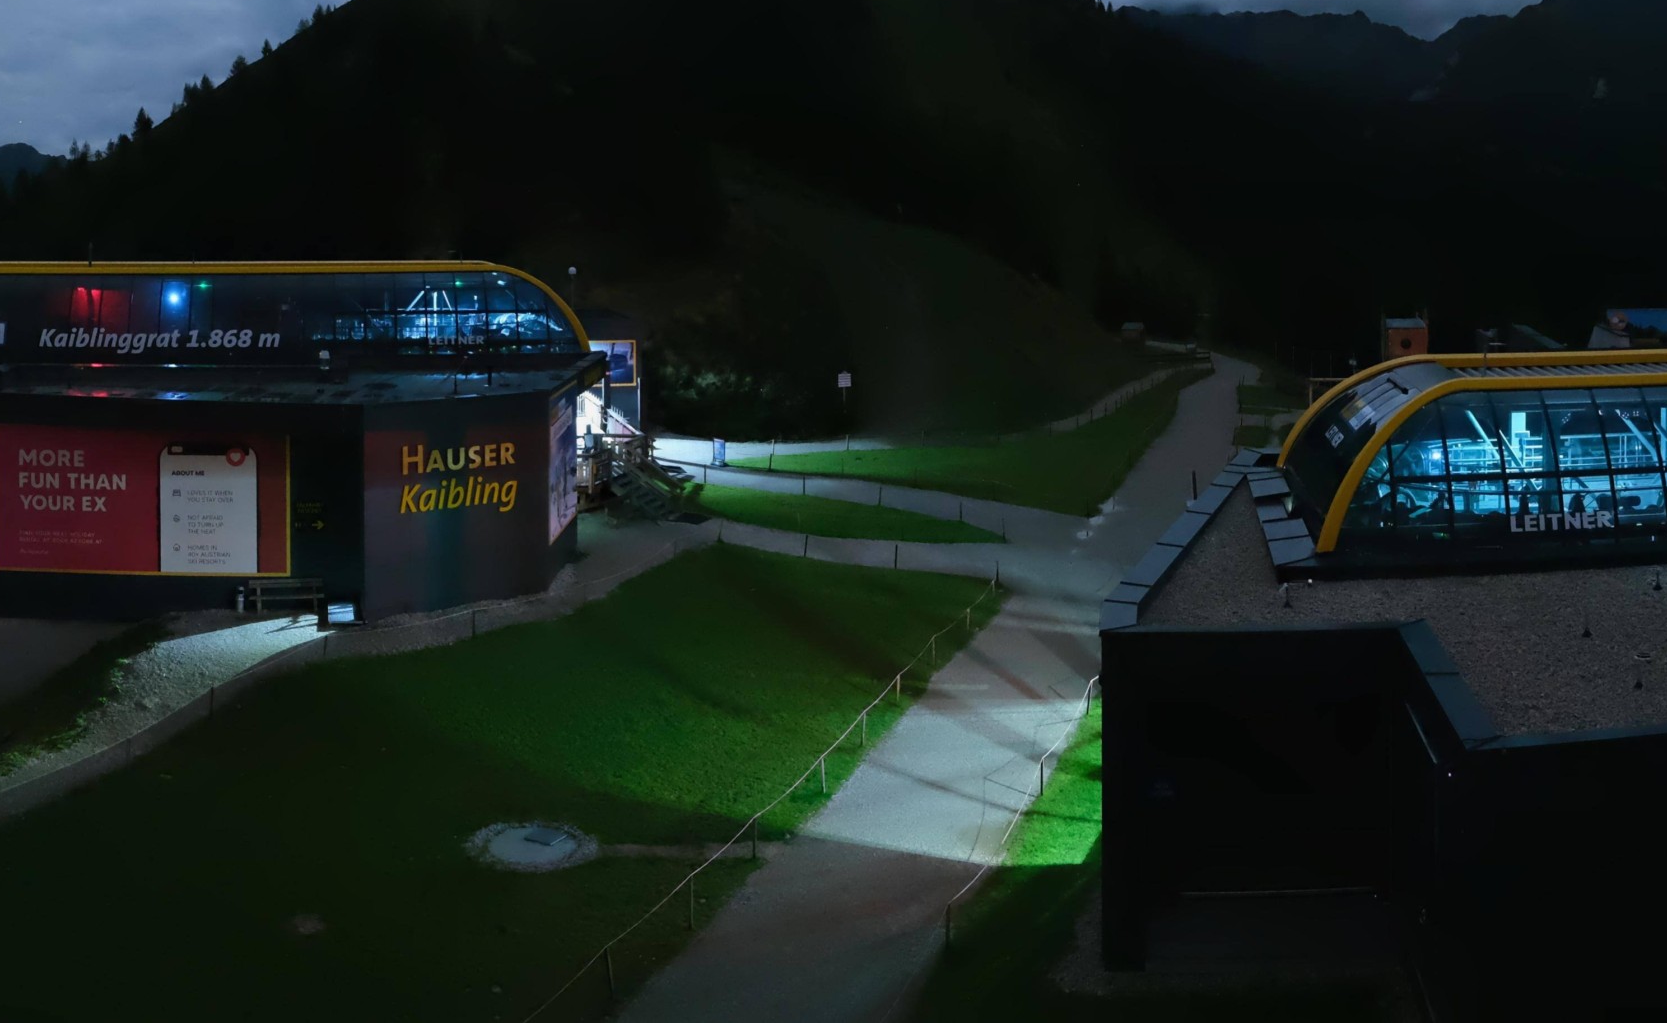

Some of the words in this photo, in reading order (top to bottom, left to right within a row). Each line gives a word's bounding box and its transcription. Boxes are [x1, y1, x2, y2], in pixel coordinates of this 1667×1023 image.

[39, 328, 180, 354] Kaiblinggrat
[186, 329, 252, 348] 1.868
[258, 333, 281, 348] m
[428, 335, 484, 346] LEITNER
[18, 449, 85, 467] MORE
[402, 442, 516, 475] HAUSER
[18, 472, 60, 489] FUN
[67, 473, 127, 491] THAN
[20, 495, 75, 511] YOUR
[82, 496, 107, 512] EX
[400, 476, 518, 514] Kaibling
[1509, 510, 1615, 533] LEITNER
